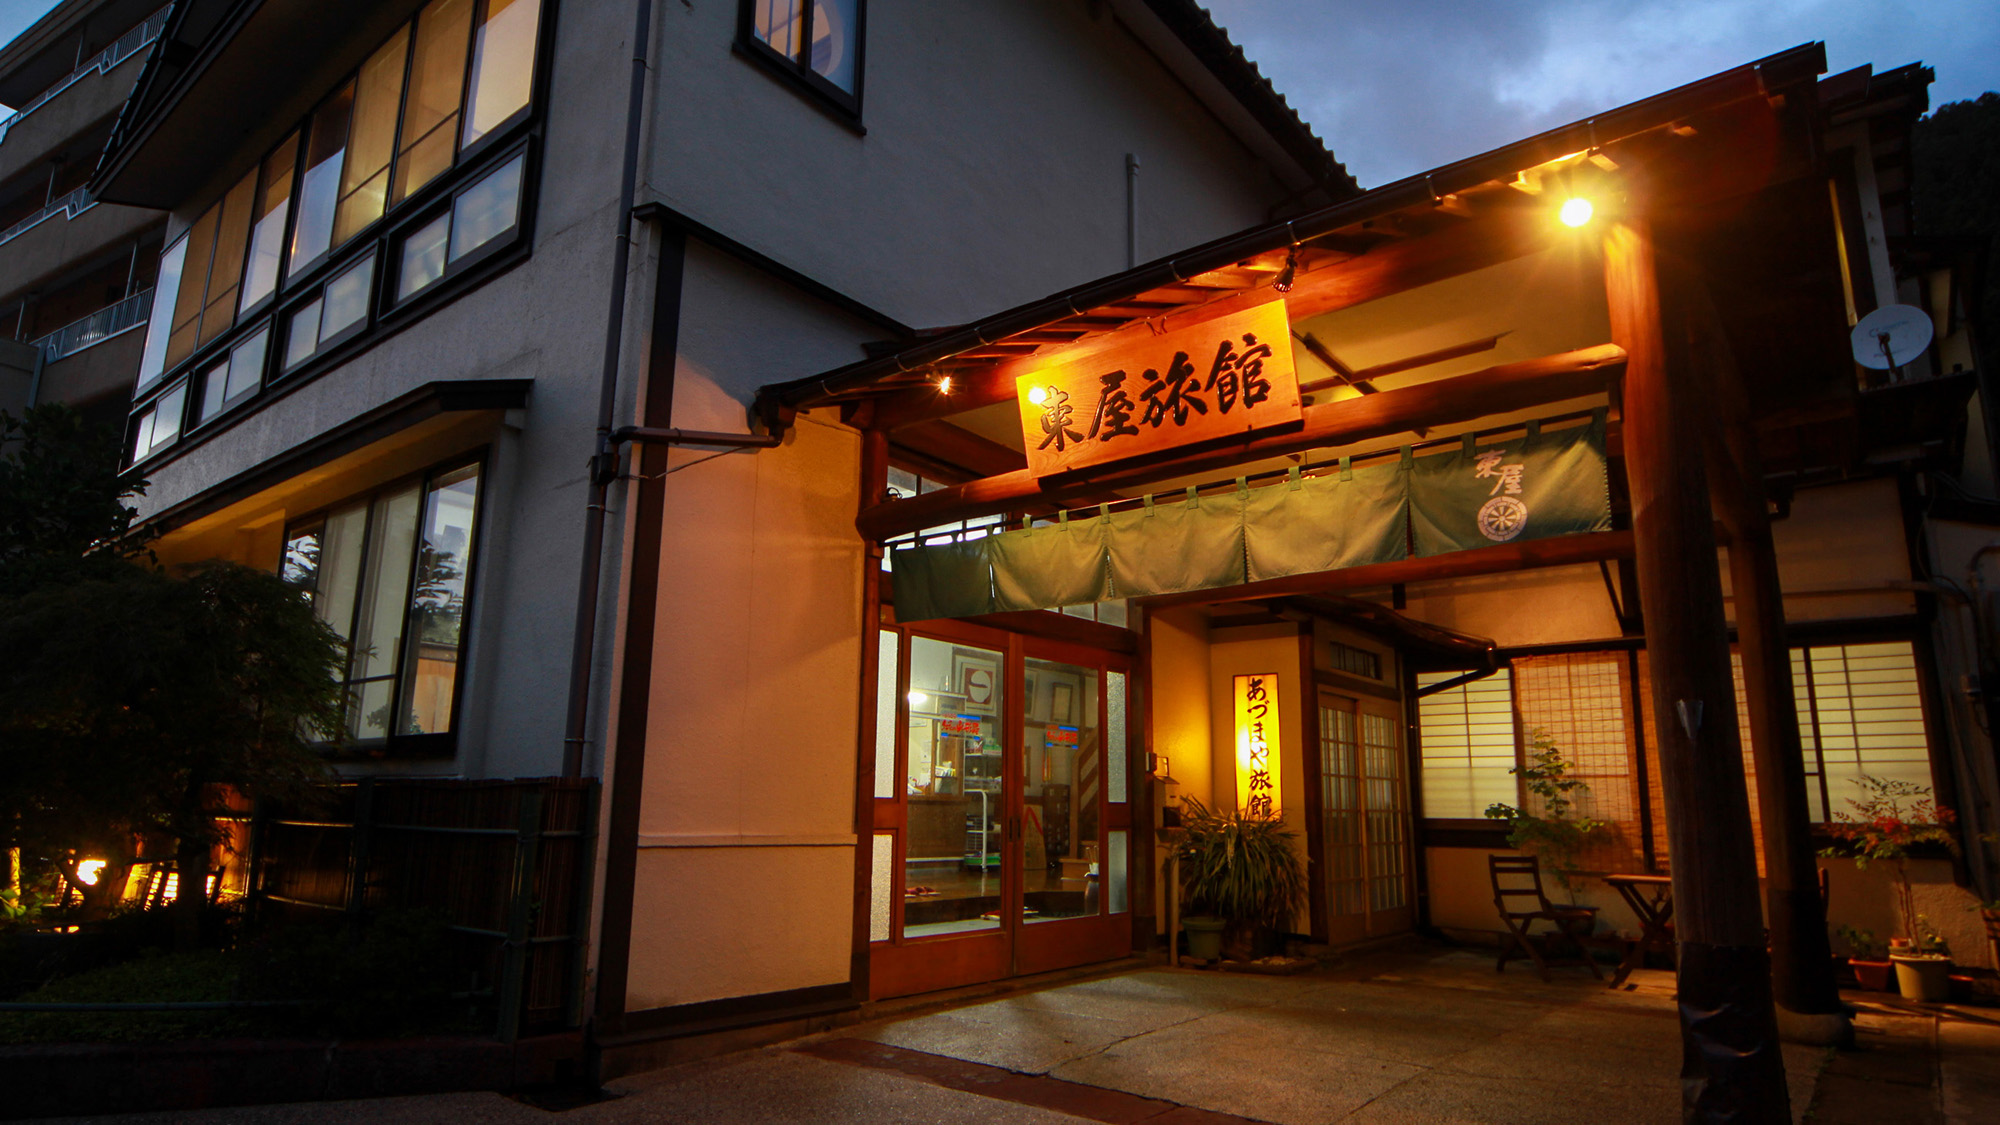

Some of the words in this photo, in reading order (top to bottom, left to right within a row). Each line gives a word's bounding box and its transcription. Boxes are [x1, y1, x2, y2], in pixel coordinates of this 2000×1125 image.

[1037, 332, 1272, 451] 東屋旅館
[1474, 449, 1524, 496] 東屋
[1247, 677, 1273, 816] あづまや旅館
